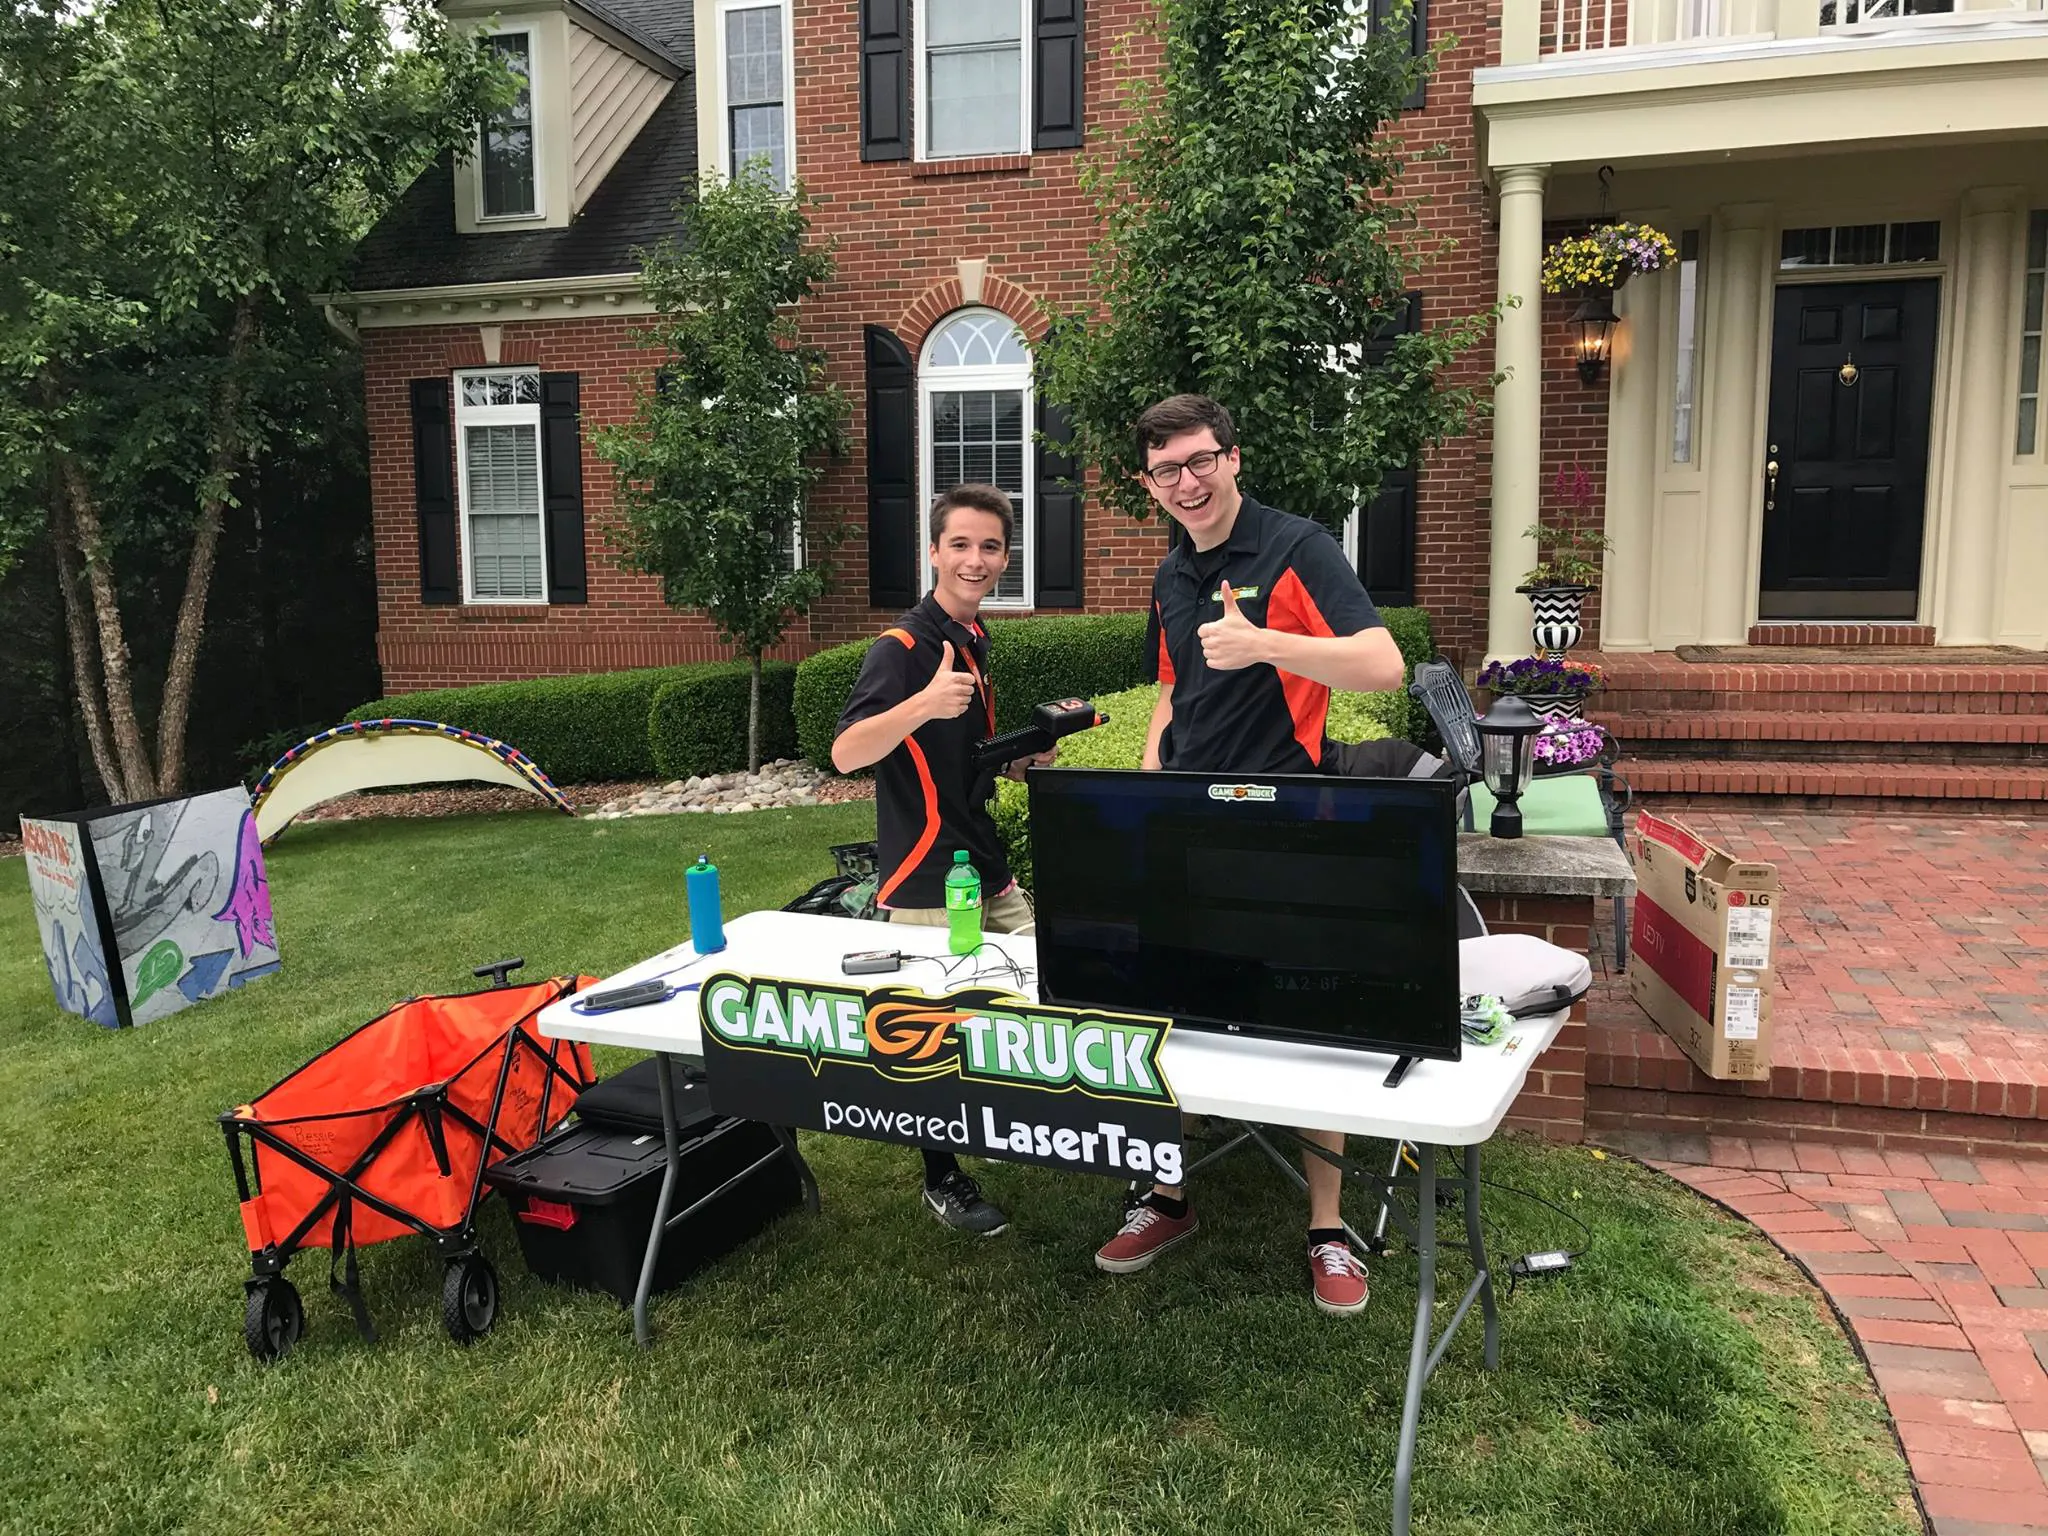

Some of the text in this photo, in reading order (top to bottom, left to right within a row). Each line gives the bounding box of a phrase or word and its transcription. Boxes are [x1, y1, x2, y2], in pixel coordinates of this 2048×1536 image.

[1211, 787, 1234, 796] GAME
[1247, 789, 1271, 798] TRUCK
[1749, 893, 1770, 906] LG
[710, 985, 866, 1054] GAME
[960, 1014, 1156, 1090] TRUCK
[823, 1100, 1184, 1186] powered LaserTag
